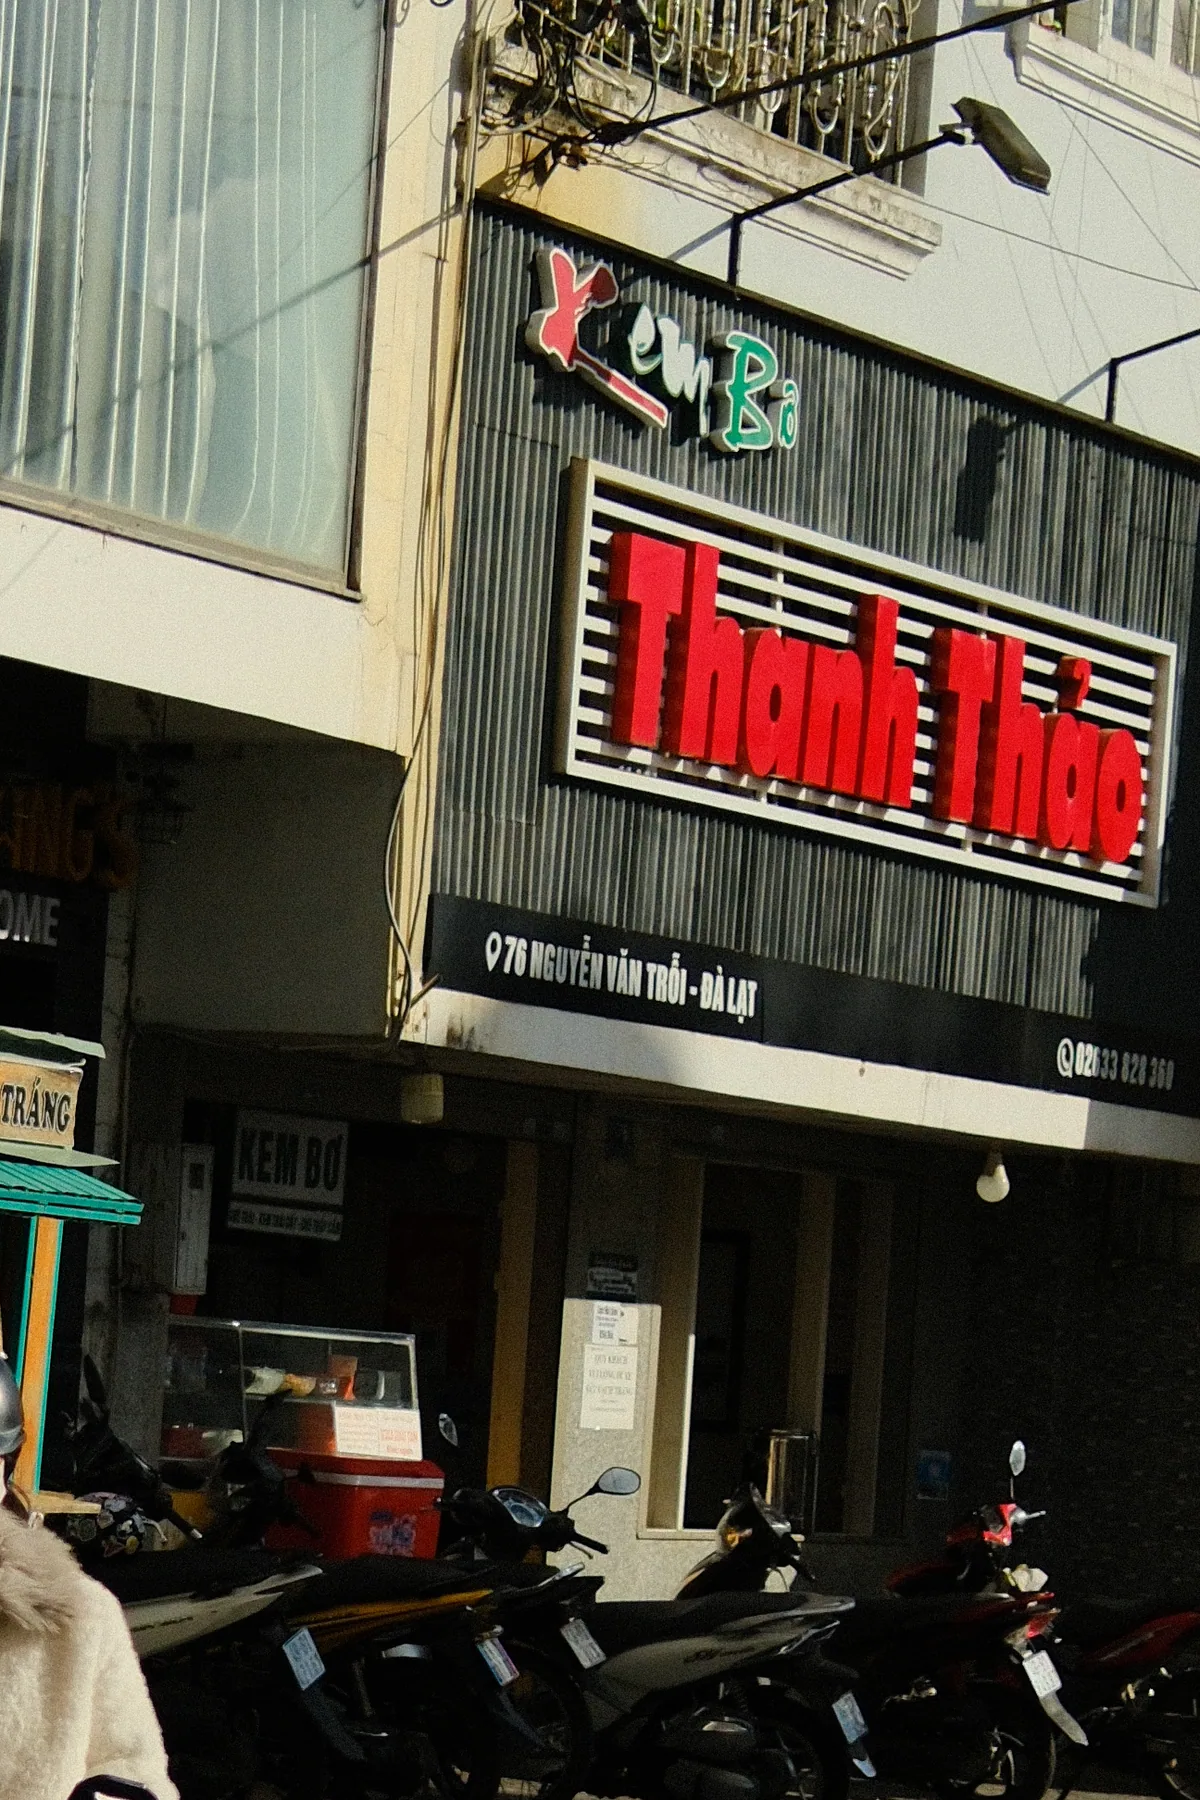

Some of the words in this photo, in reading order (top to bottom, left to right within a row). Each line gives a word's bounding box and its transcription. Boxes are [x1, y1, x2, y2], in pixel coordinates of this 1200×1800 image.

[609, 532, 920, 808] Thanh
[935, 627, 1145, 865] Thảo
[503, 935, 528, 977] 76
[529, 934, 604, 990] NGUYỄN
[606, 947, 643, 998] VĂN
[646, 952, 687, 1006] TRỖI
[700, 965, 725, 1012] ĐÀ
[726, 976, 758, 1025] LẠT
[1, 1076, 71, 1133] TRÁNG
[239, 1127, 298, 1186] KEM
